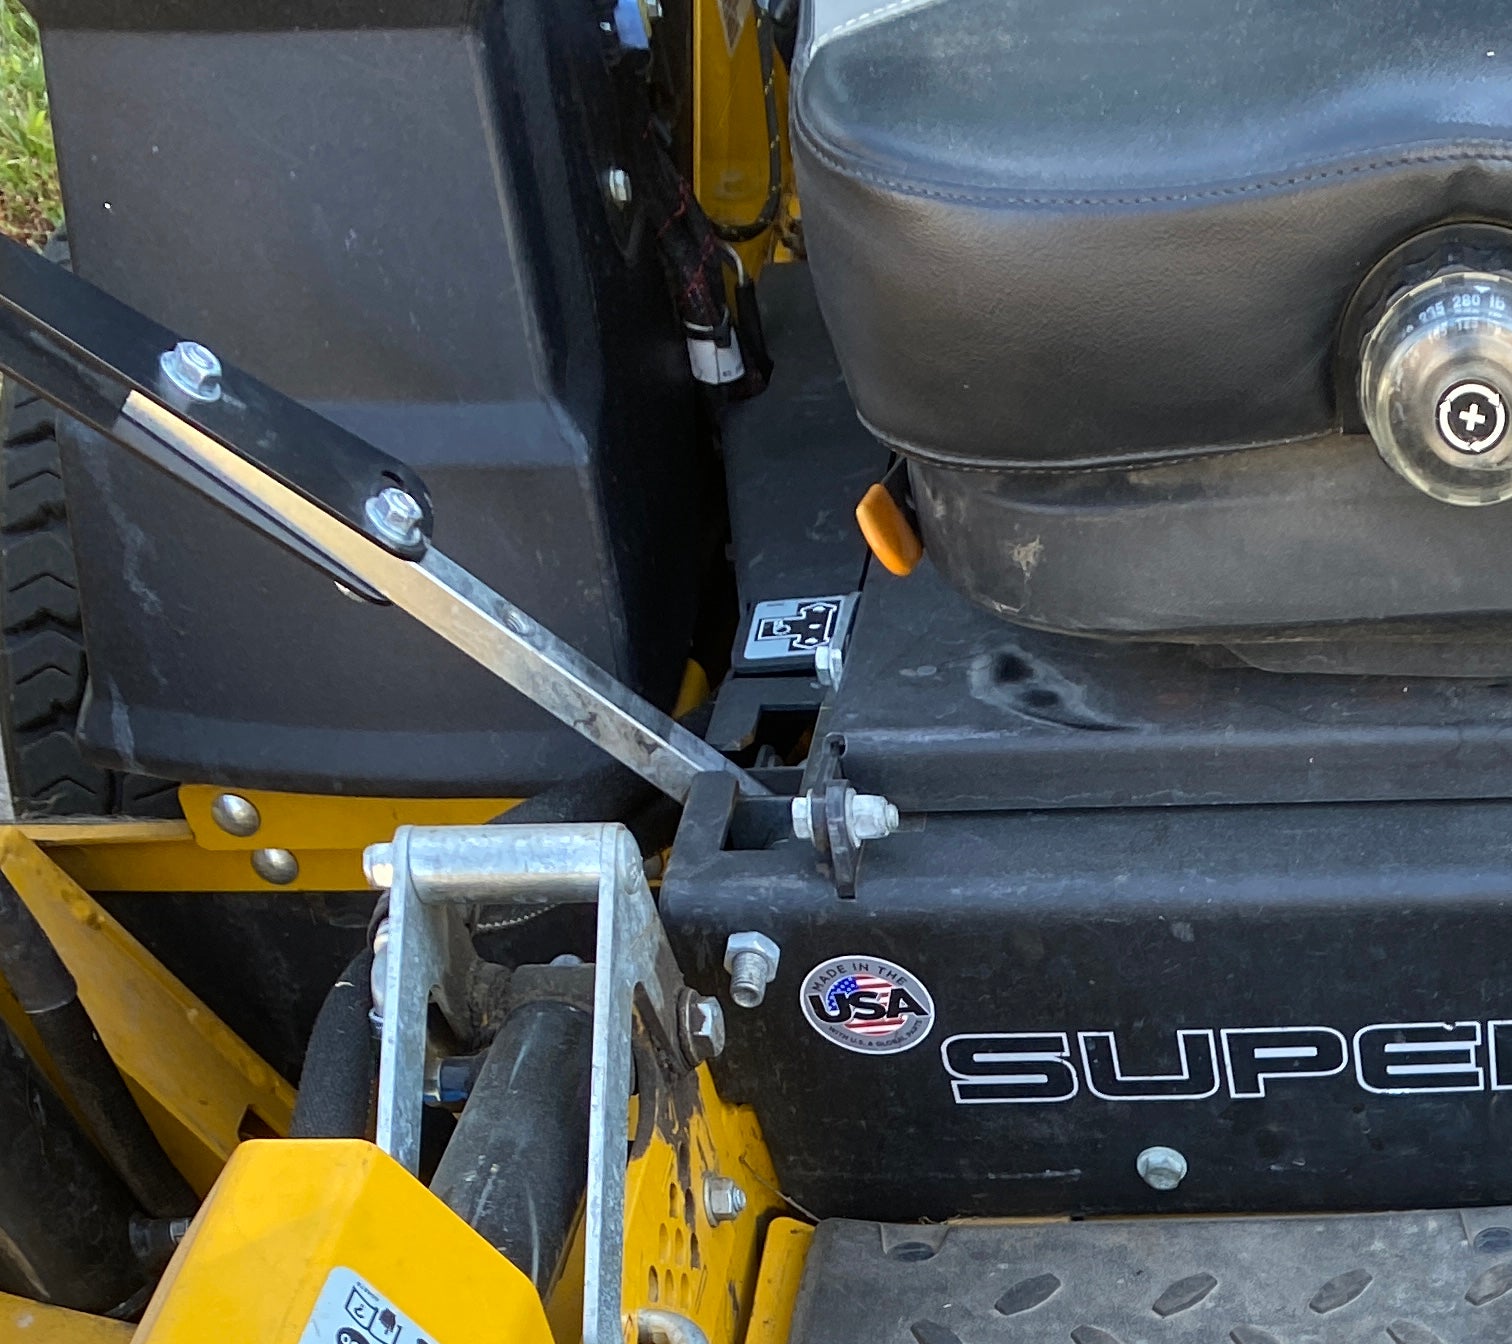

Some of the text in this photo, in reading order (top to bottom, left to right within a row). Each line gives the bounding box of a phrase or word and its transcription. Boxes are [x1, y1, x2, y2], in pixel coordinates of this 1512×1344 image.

[1452, 294, 1481, 310] 280
[812, 963, 908, 992] MADE IN THE
[808, 987, 929, 1023] USA
